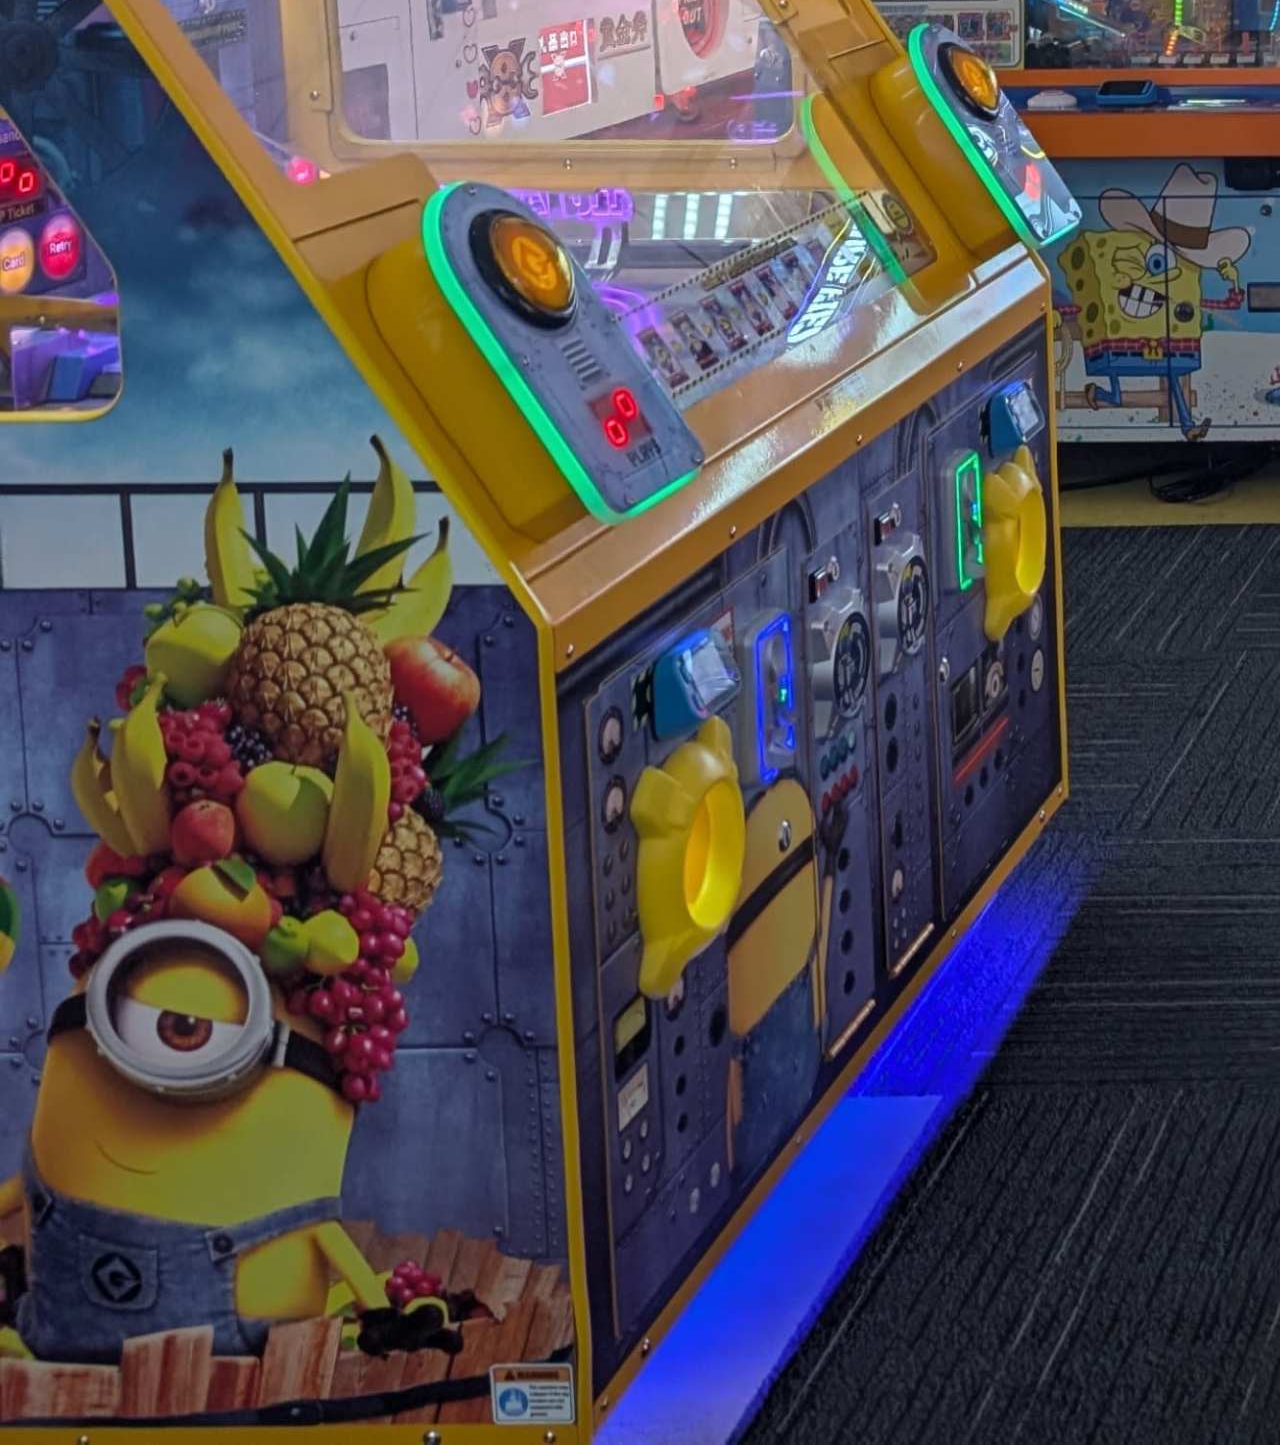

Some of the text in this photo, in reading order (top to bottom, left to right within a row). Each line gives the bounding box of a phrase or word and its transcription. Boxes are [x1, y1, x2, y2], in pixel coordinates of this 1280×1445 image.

[680, 6, 702, 26] OUT
[49, 240, 72, 254] Retry
[3, 256, 26, 271] Card
